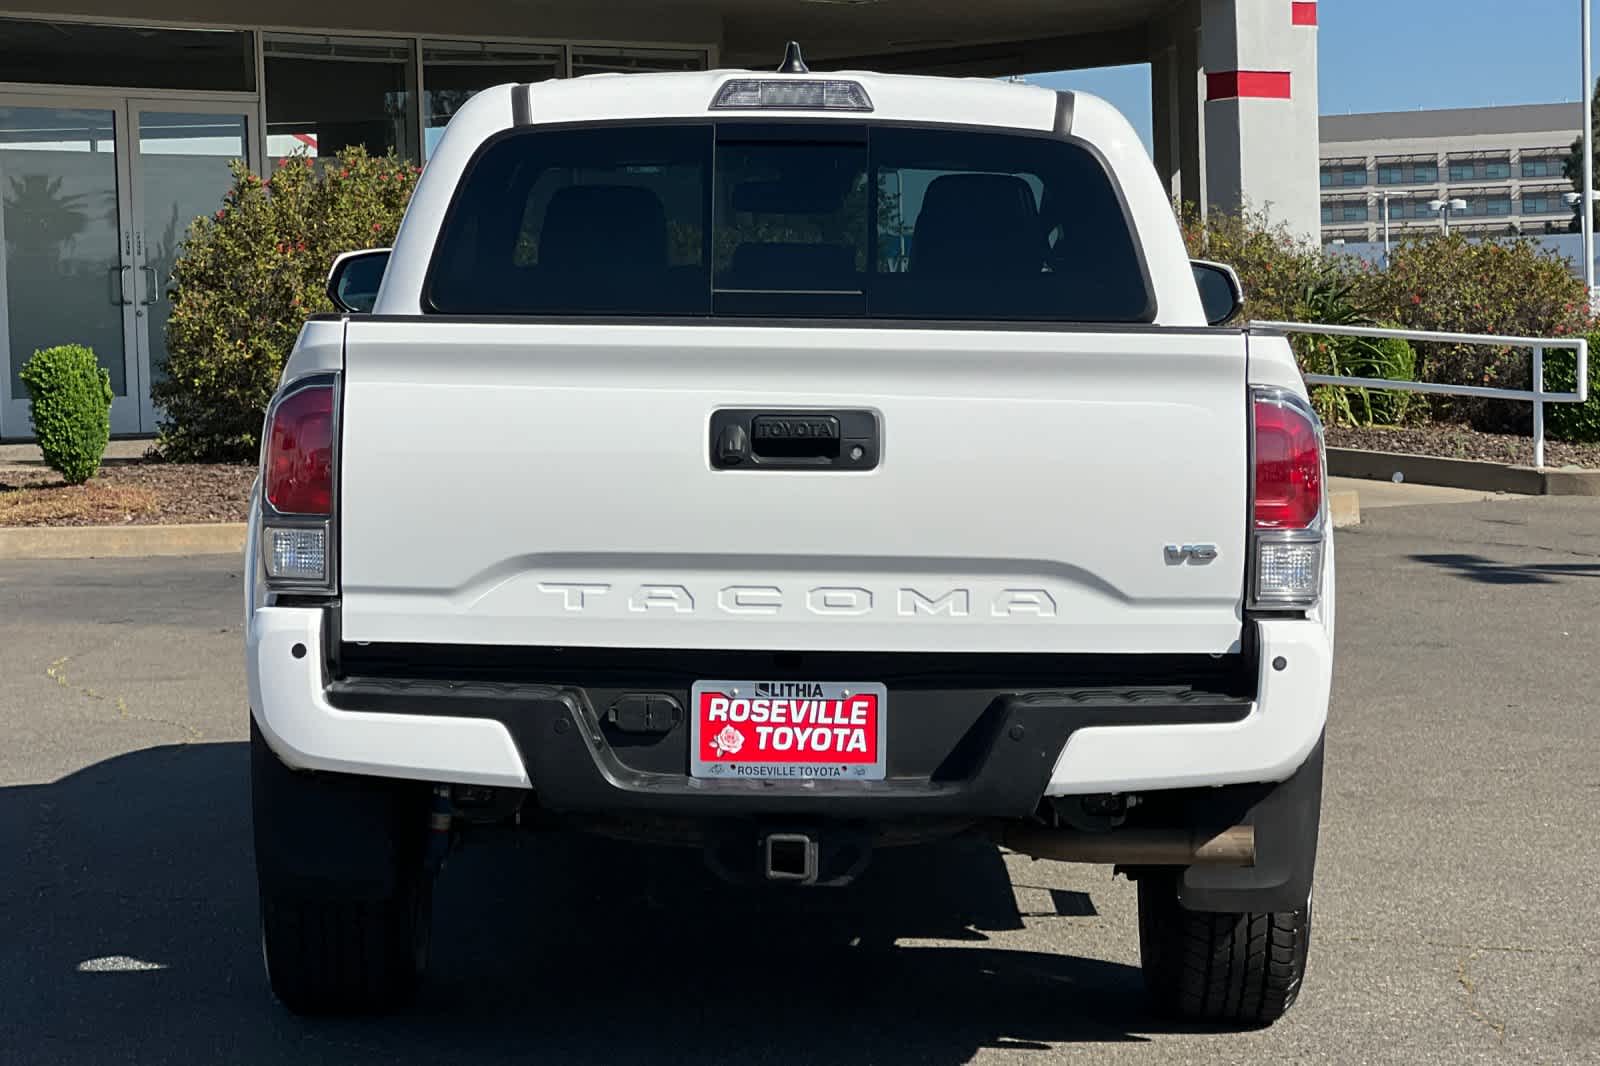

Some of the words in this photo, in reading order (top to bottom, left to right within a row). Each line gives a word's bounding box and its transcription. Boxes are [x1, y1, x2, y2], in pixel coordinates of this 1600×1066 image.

[758, 420, 834, 438] TOYOTA
[1163, 544, 1218, 566] V6
[536, 582, 1057, 617] TACOMA
[769, 683, 824, 698] LITHIA
[708, 697, 869, 725] ROSEVILLE
[755, 726, 868, 753] TOYOTA
[736, 765, 796, 777] ROSEVILLE
[798, 766, 842, 777] TOYOTA
